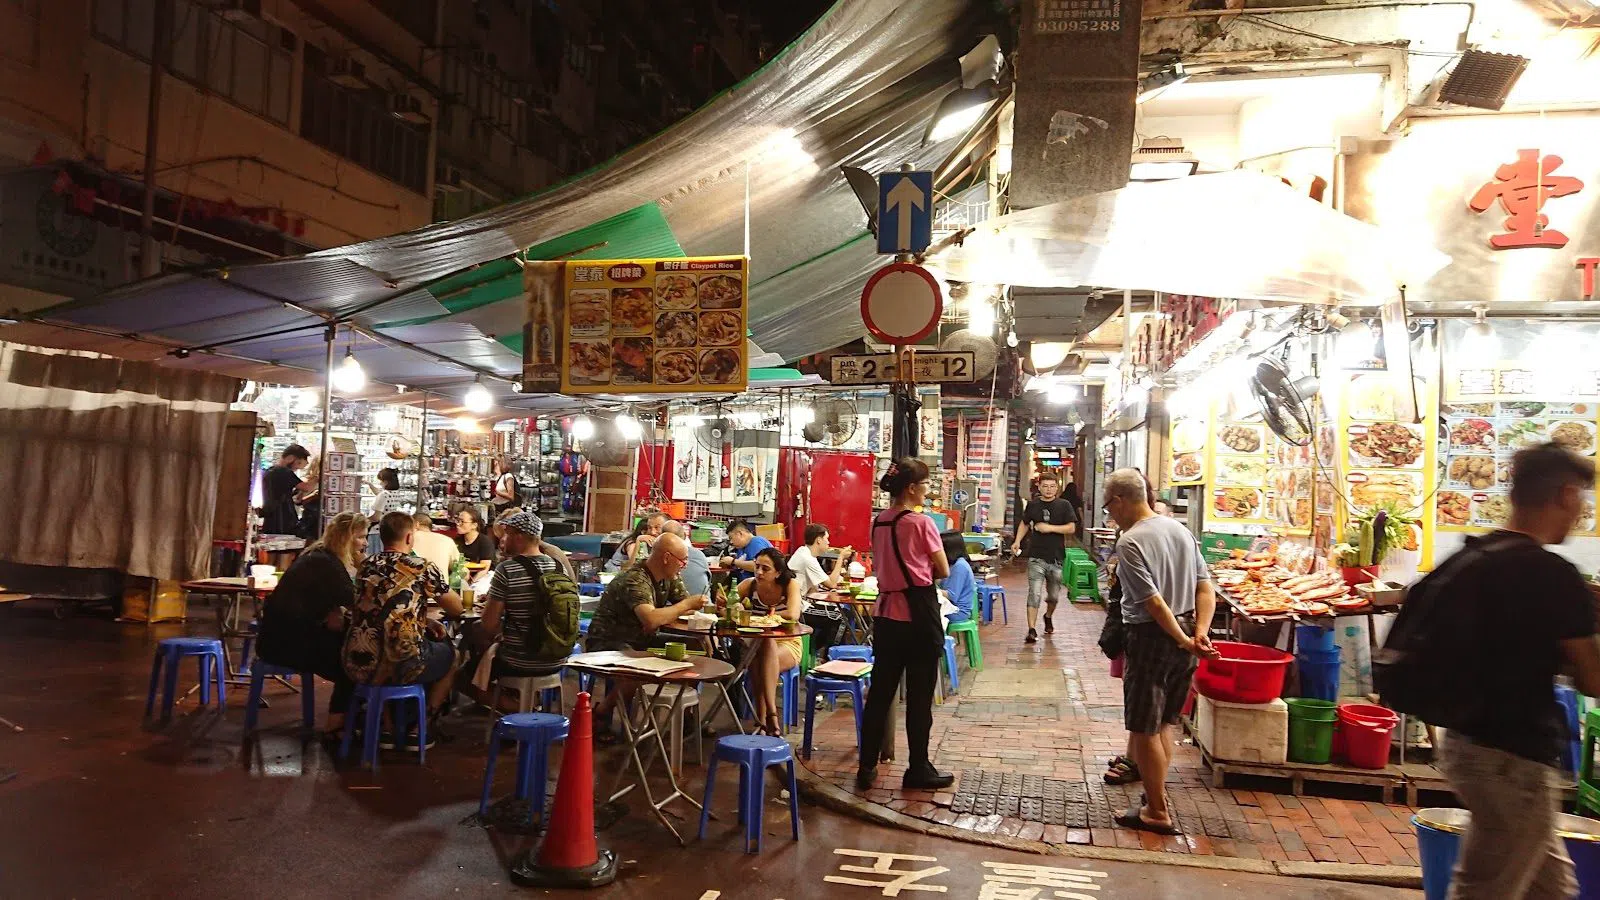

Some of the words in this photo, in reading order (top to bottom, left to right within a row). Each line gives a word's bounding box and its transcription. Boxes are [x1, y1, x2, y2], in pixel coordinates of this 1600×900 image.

[1038, 20, 1121, 32] 93095288
[1470, 149, 1585, 250] 堂
[611, 265, 642, 279] 招牌菜
[690, 262, 717, 270] Claypot
[573, 266, 604, 283] 堂泰
[837, 368, 859, 379] 下午
[863, 359, 877, 379] 2
[903, 357, 938, 365] mdnight
[941, 357, 967, 377] 12
